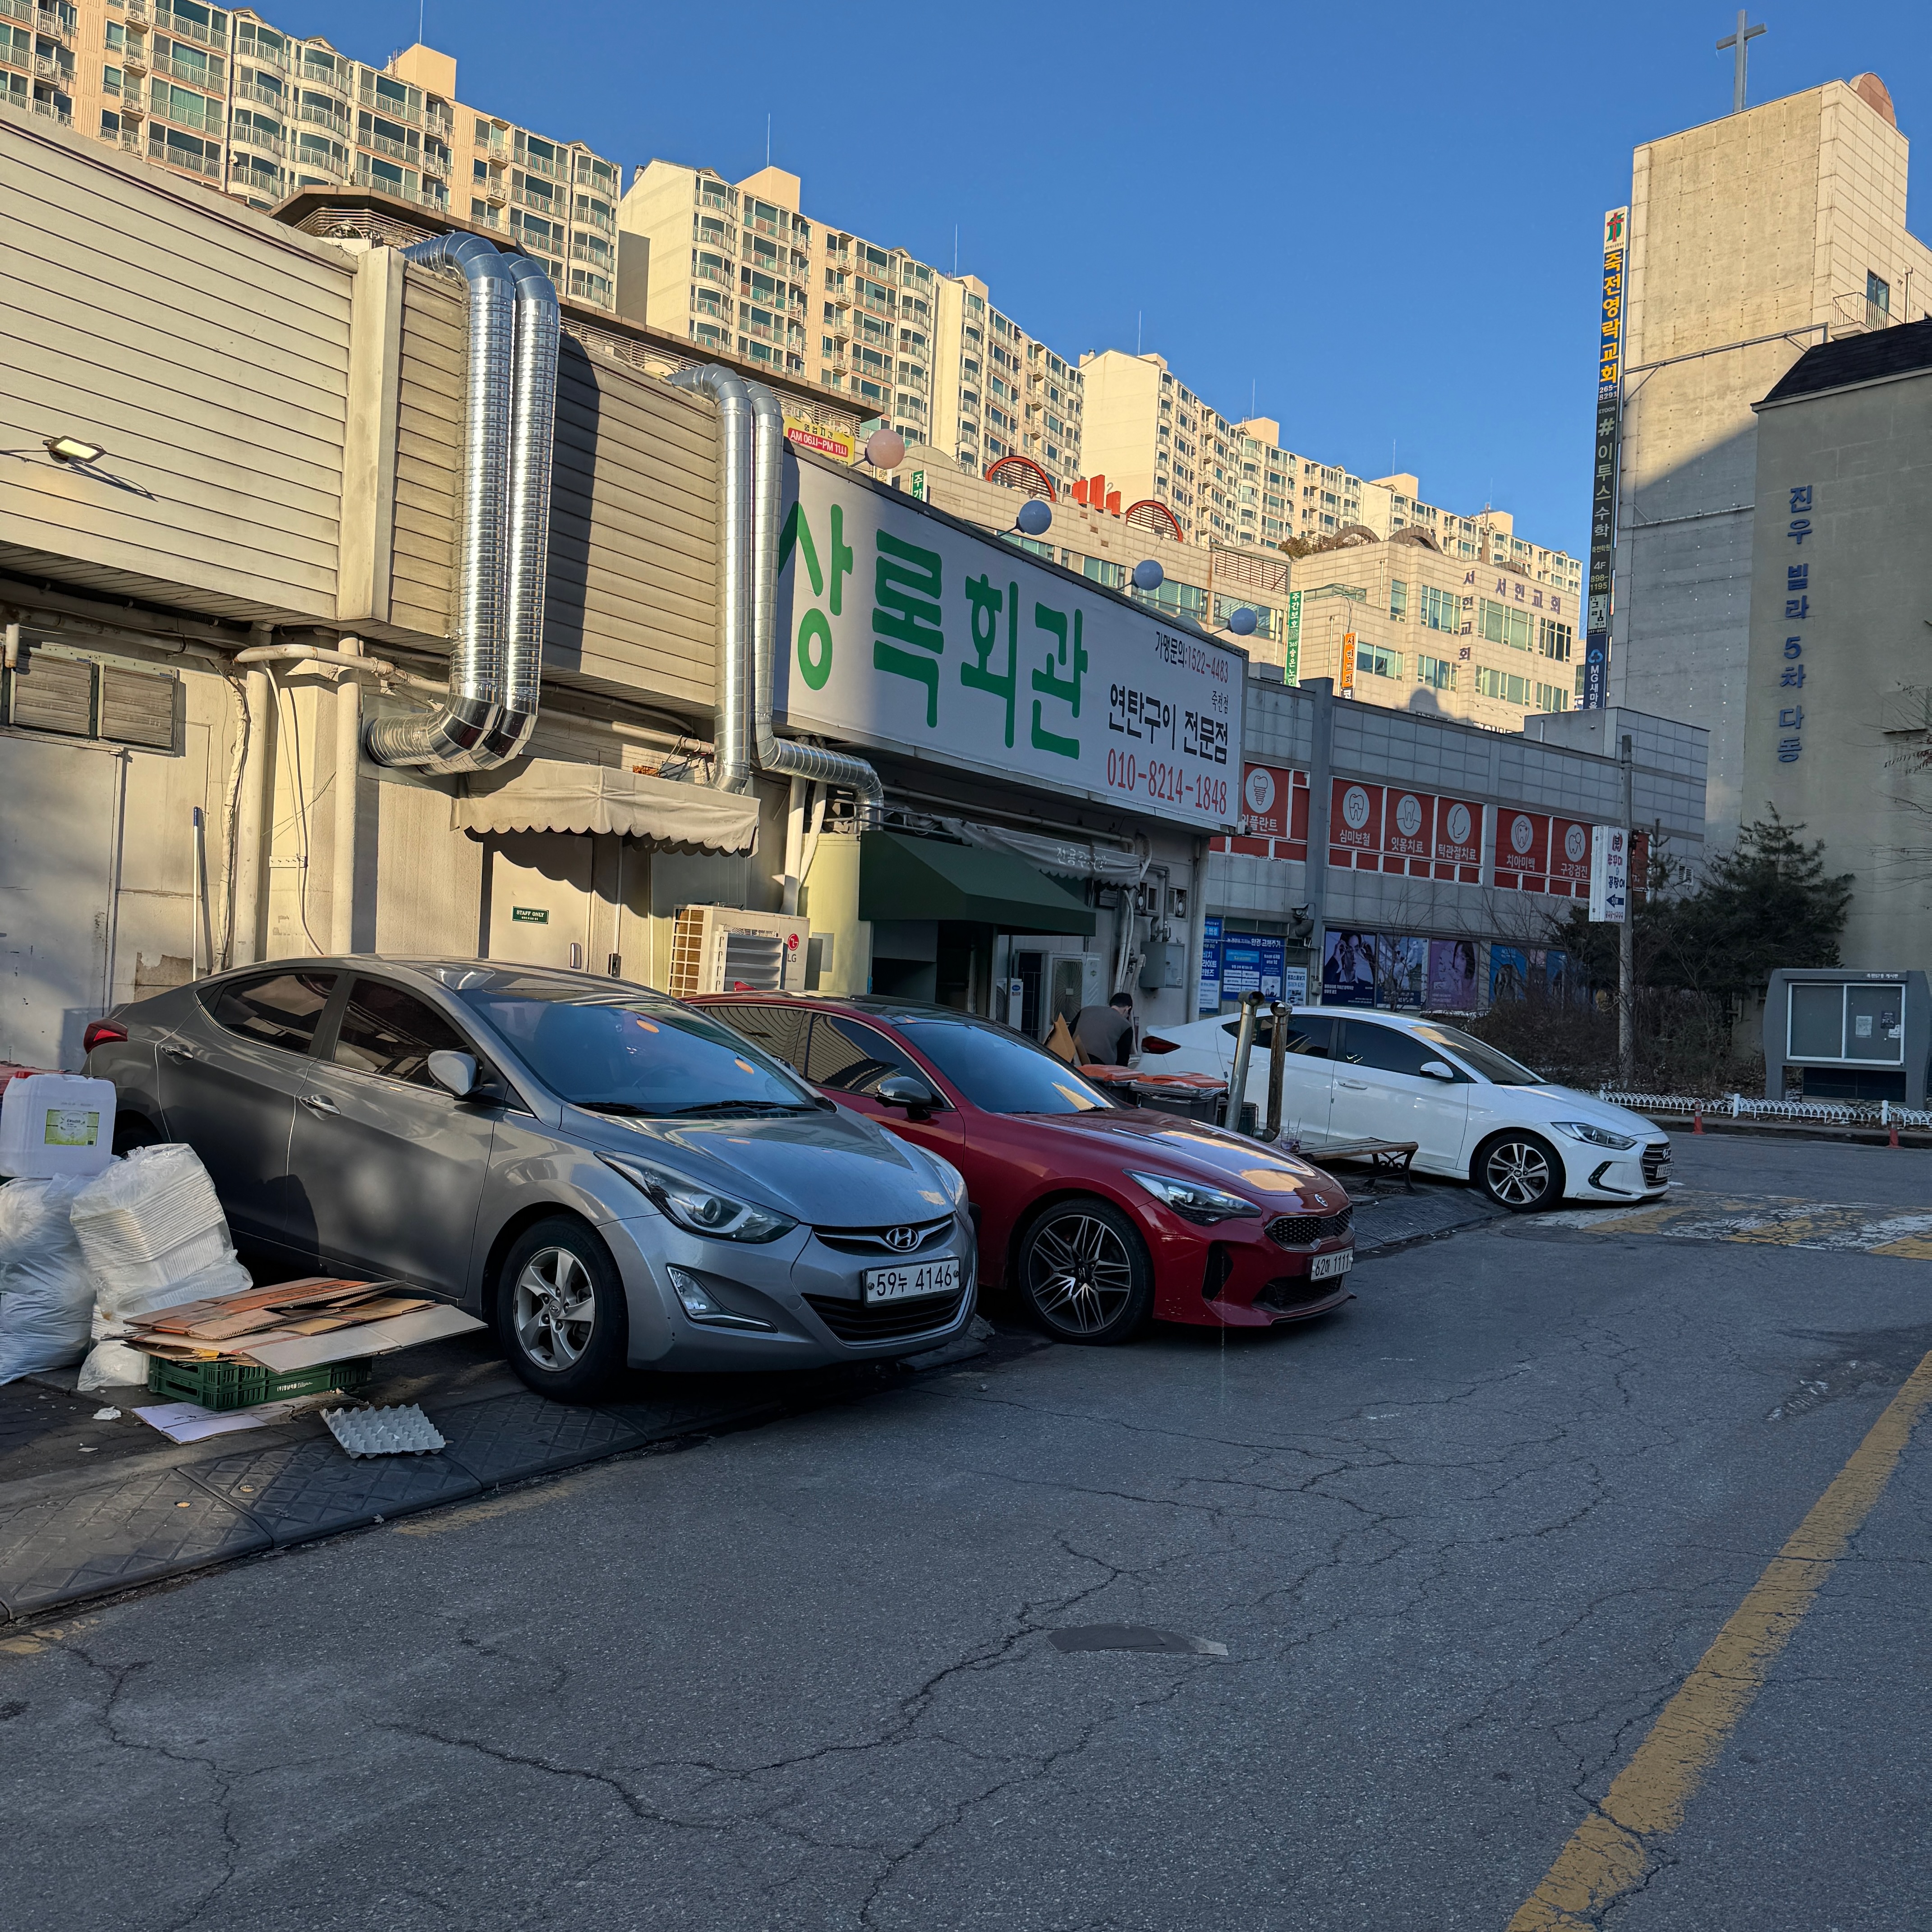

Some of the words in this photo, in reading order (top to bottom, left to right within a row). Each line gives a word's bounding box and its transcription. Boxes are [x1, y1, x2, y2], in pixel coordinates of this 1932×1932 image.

[1600, 252, 1623, 383] 죽전영락교회
[1599, 385, 1618, 394] 265-
[1599, 391, 1618, 401] 8291
[790, 430, 802, 442] AM
[1594, 561, 1606, 570] 4F
[1590, 574, 1609, 583] 898-
[1591, 582, 1608, 592] 1195
[1291, 593, 1300, 629] 주간보호
[778, 501, 1088, 760] 상록회관
[1780, 636, 1806, 688] 5차
[1212, 690, 1228, 714] 죽전점
[1109, 683, 1176, 750] 연탄구이
[1184, 710, 1228, 764] 전문점
[1777, 705, 1804, 764] 다동
[1107, 748, 1227, 815] 010-8214-1848
[1339, 829, 1370, 846] 심미보철
[1391, 836, 1424, 853] 잇몸치료
[1439, 844, 1477, 861] 턱관절치료
[1507, 855, 1535, 870] 치아미백
[1561, 863, 1587, 879] 구강검진
[787, 954, 797, 962] LG
[1334, 1253, 1349, 1272] 1111
[877, 1272, 907, 1296] 59누
[915, 1265, 952, 1290] 4146
